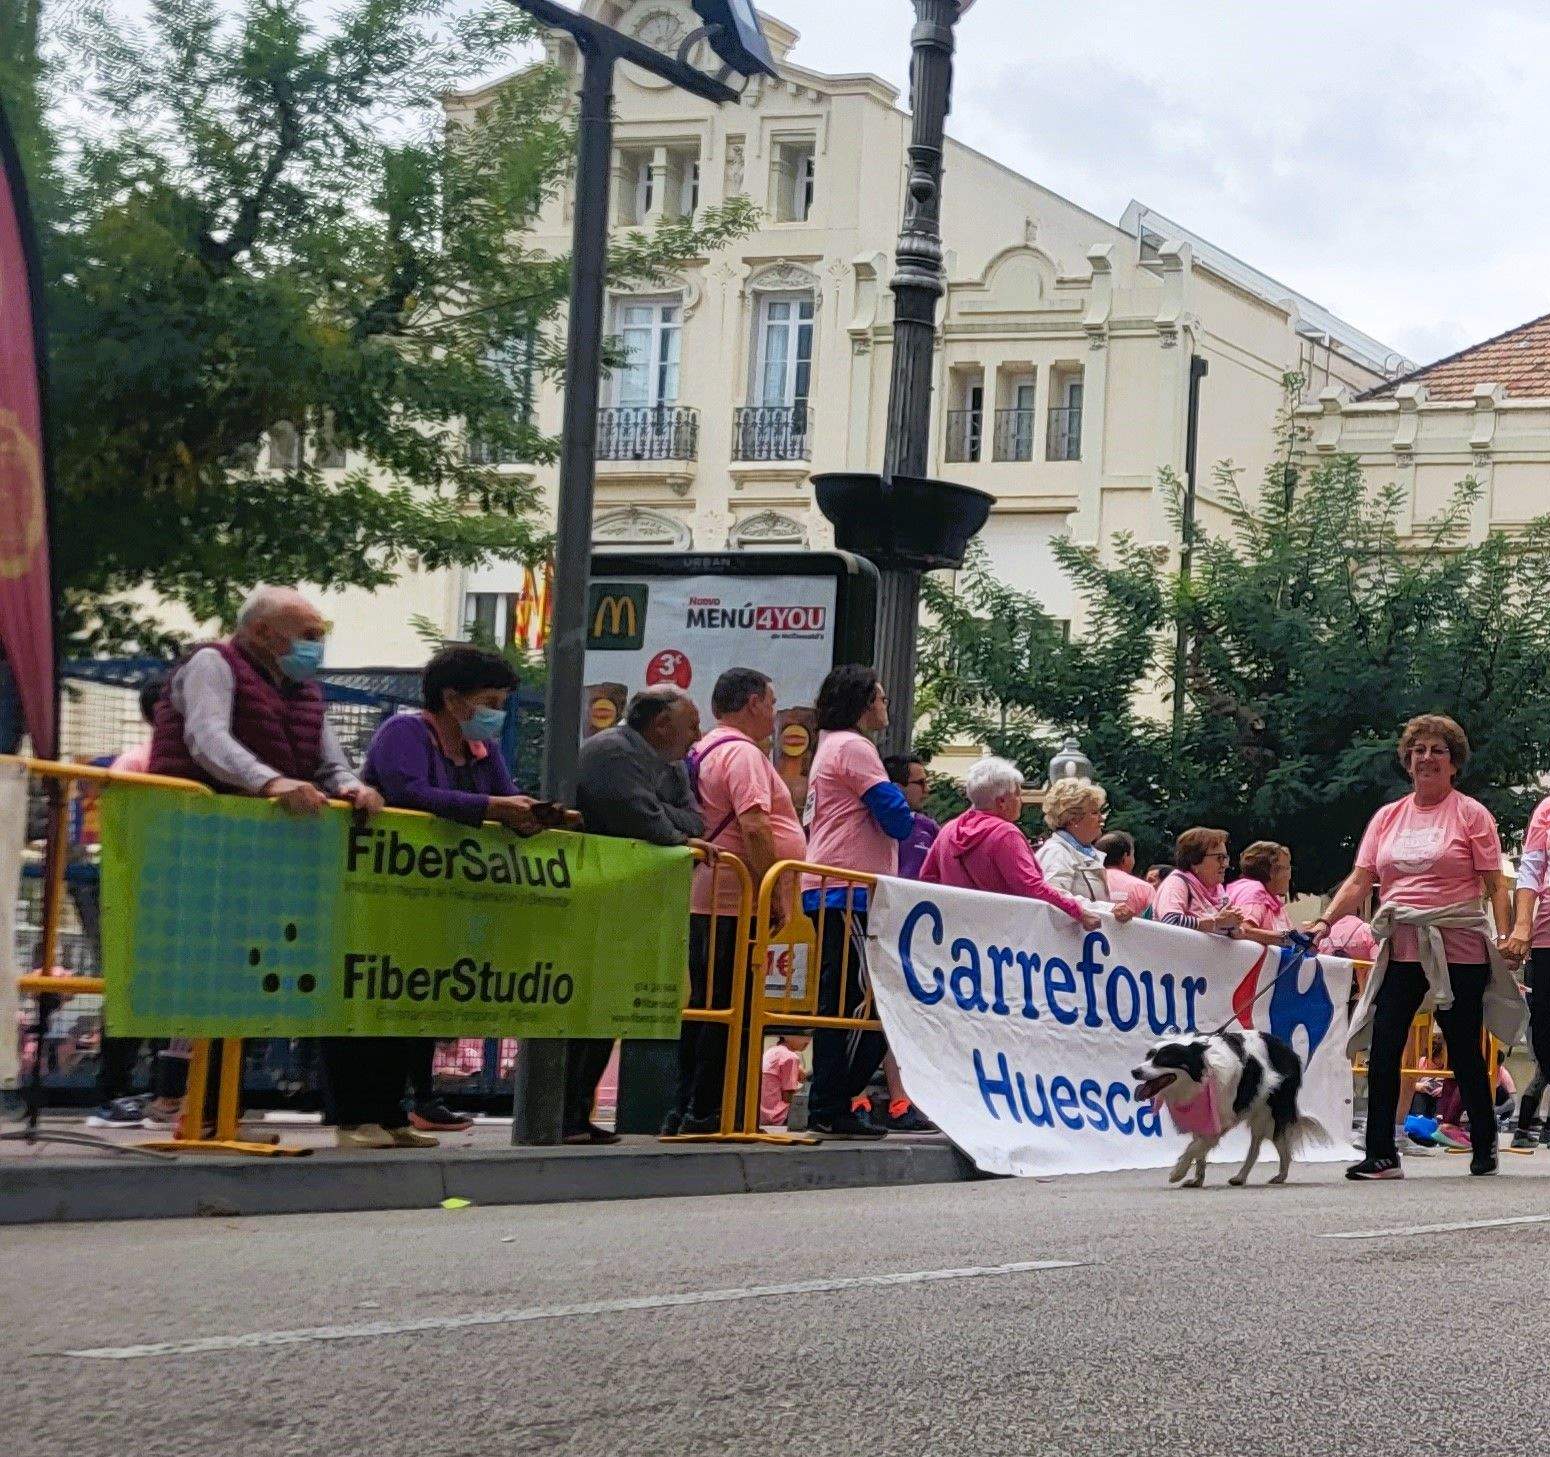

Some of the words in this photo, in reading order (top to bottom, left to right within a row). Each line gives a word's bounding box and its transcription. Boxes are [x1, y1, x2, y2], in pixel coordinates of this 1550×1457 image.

[689, 596, 720, 606] Nuevo
[347, 826, 572, 889] FiberSalud
[343, 953, 575, 1005] FiberStudio
[898, 900, 1208, 1036] Carrefour
[972, 1048, 1163, 1138] Huesca
